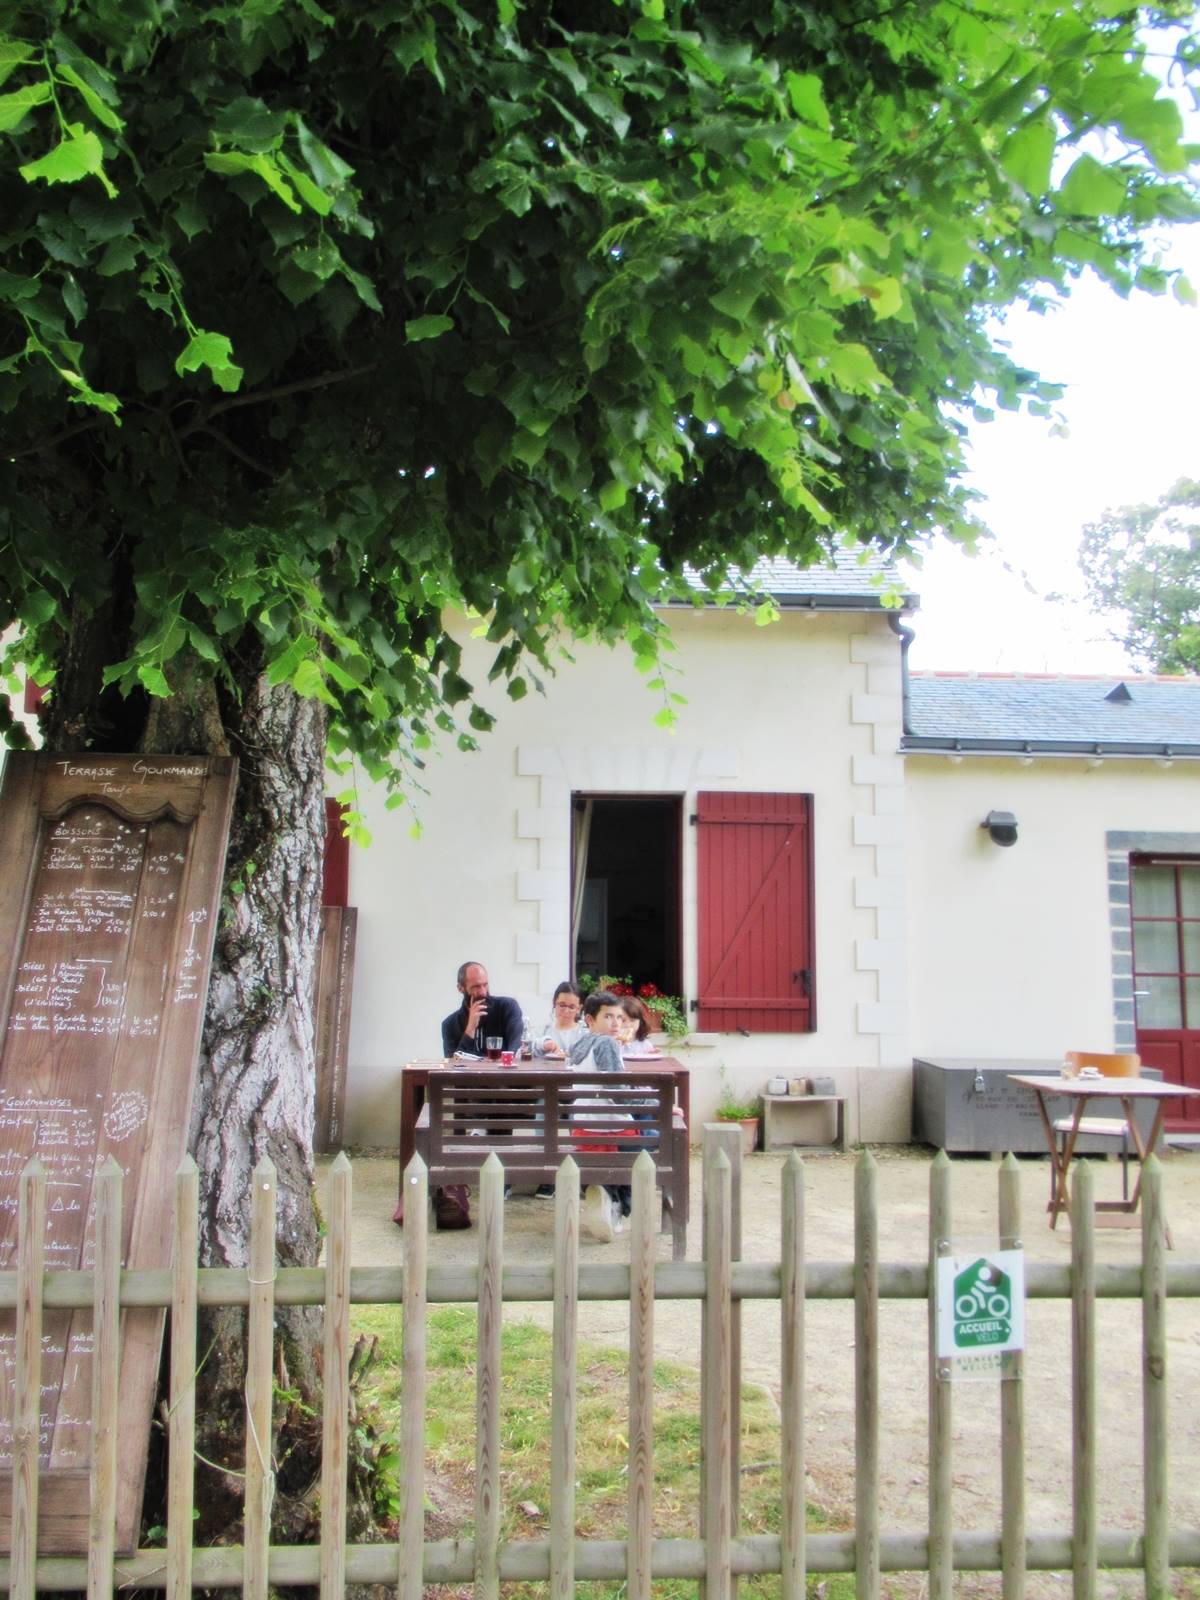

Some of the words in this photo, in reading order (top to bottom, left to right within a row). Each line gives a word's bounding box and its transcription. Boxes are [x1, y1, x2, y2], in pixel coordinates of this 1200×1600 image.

[56, 761, 118, 780] TERRASSE
[132, 760, 208, 784] GOURMANDE
[54, 827, 102, 836] BOISSONS
[959, 1321, 1003, 1335] ACCUEIL
